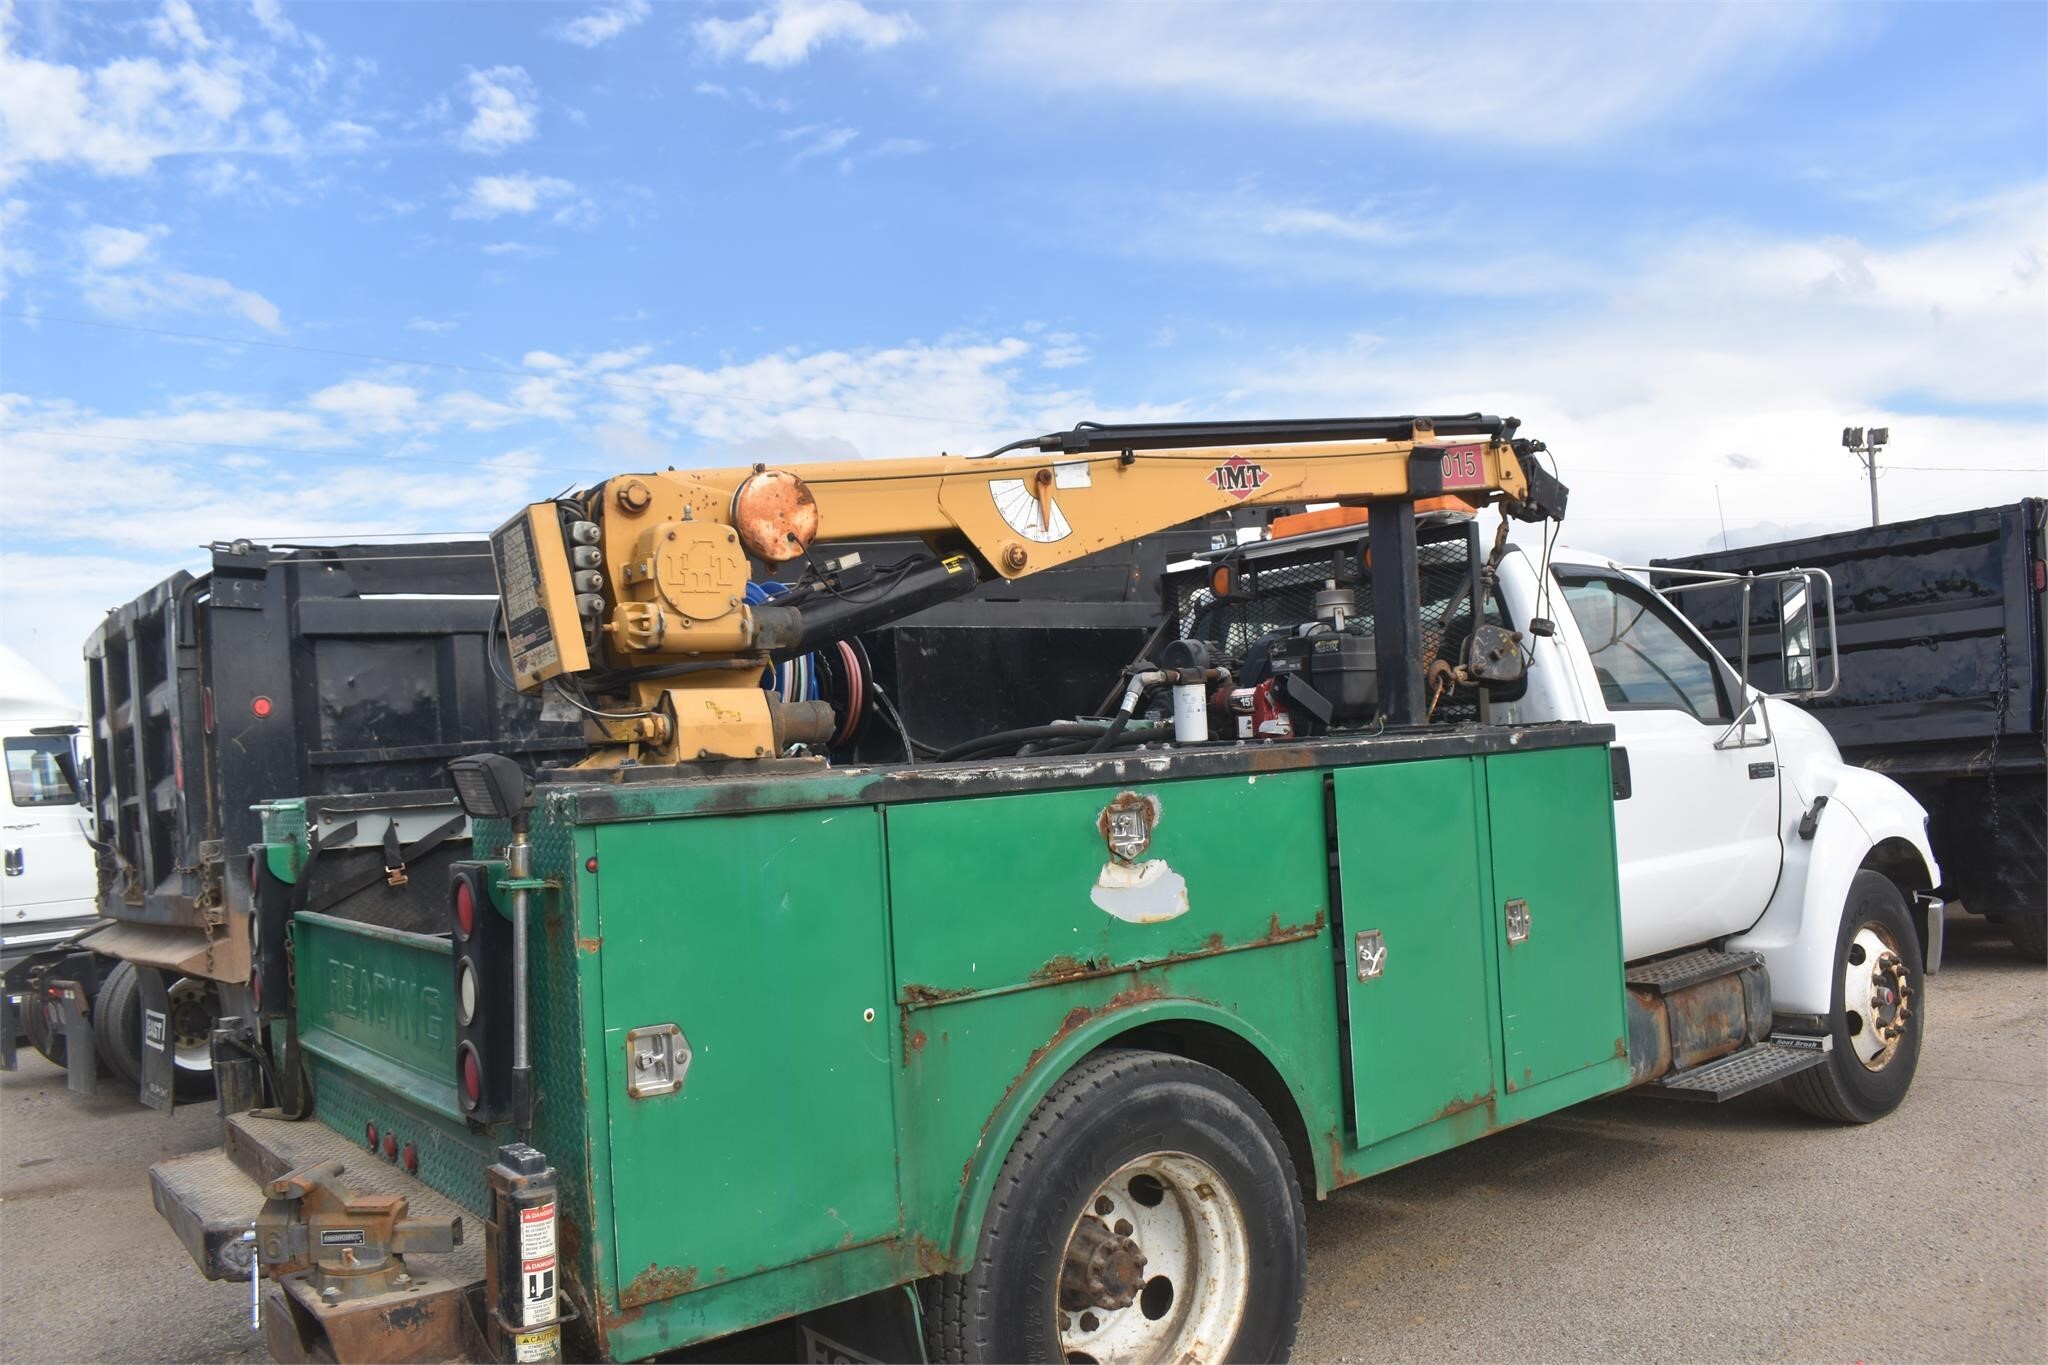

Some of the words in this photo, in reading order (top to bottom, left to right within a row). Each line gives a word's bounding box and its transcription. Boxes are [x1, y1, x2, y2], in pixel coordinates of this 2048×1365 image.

[1216, 465, 1261, 490] IMT
[531, 1208, 554, 1219] DANGER
[531, 1257, 555, 1269] DANGER
